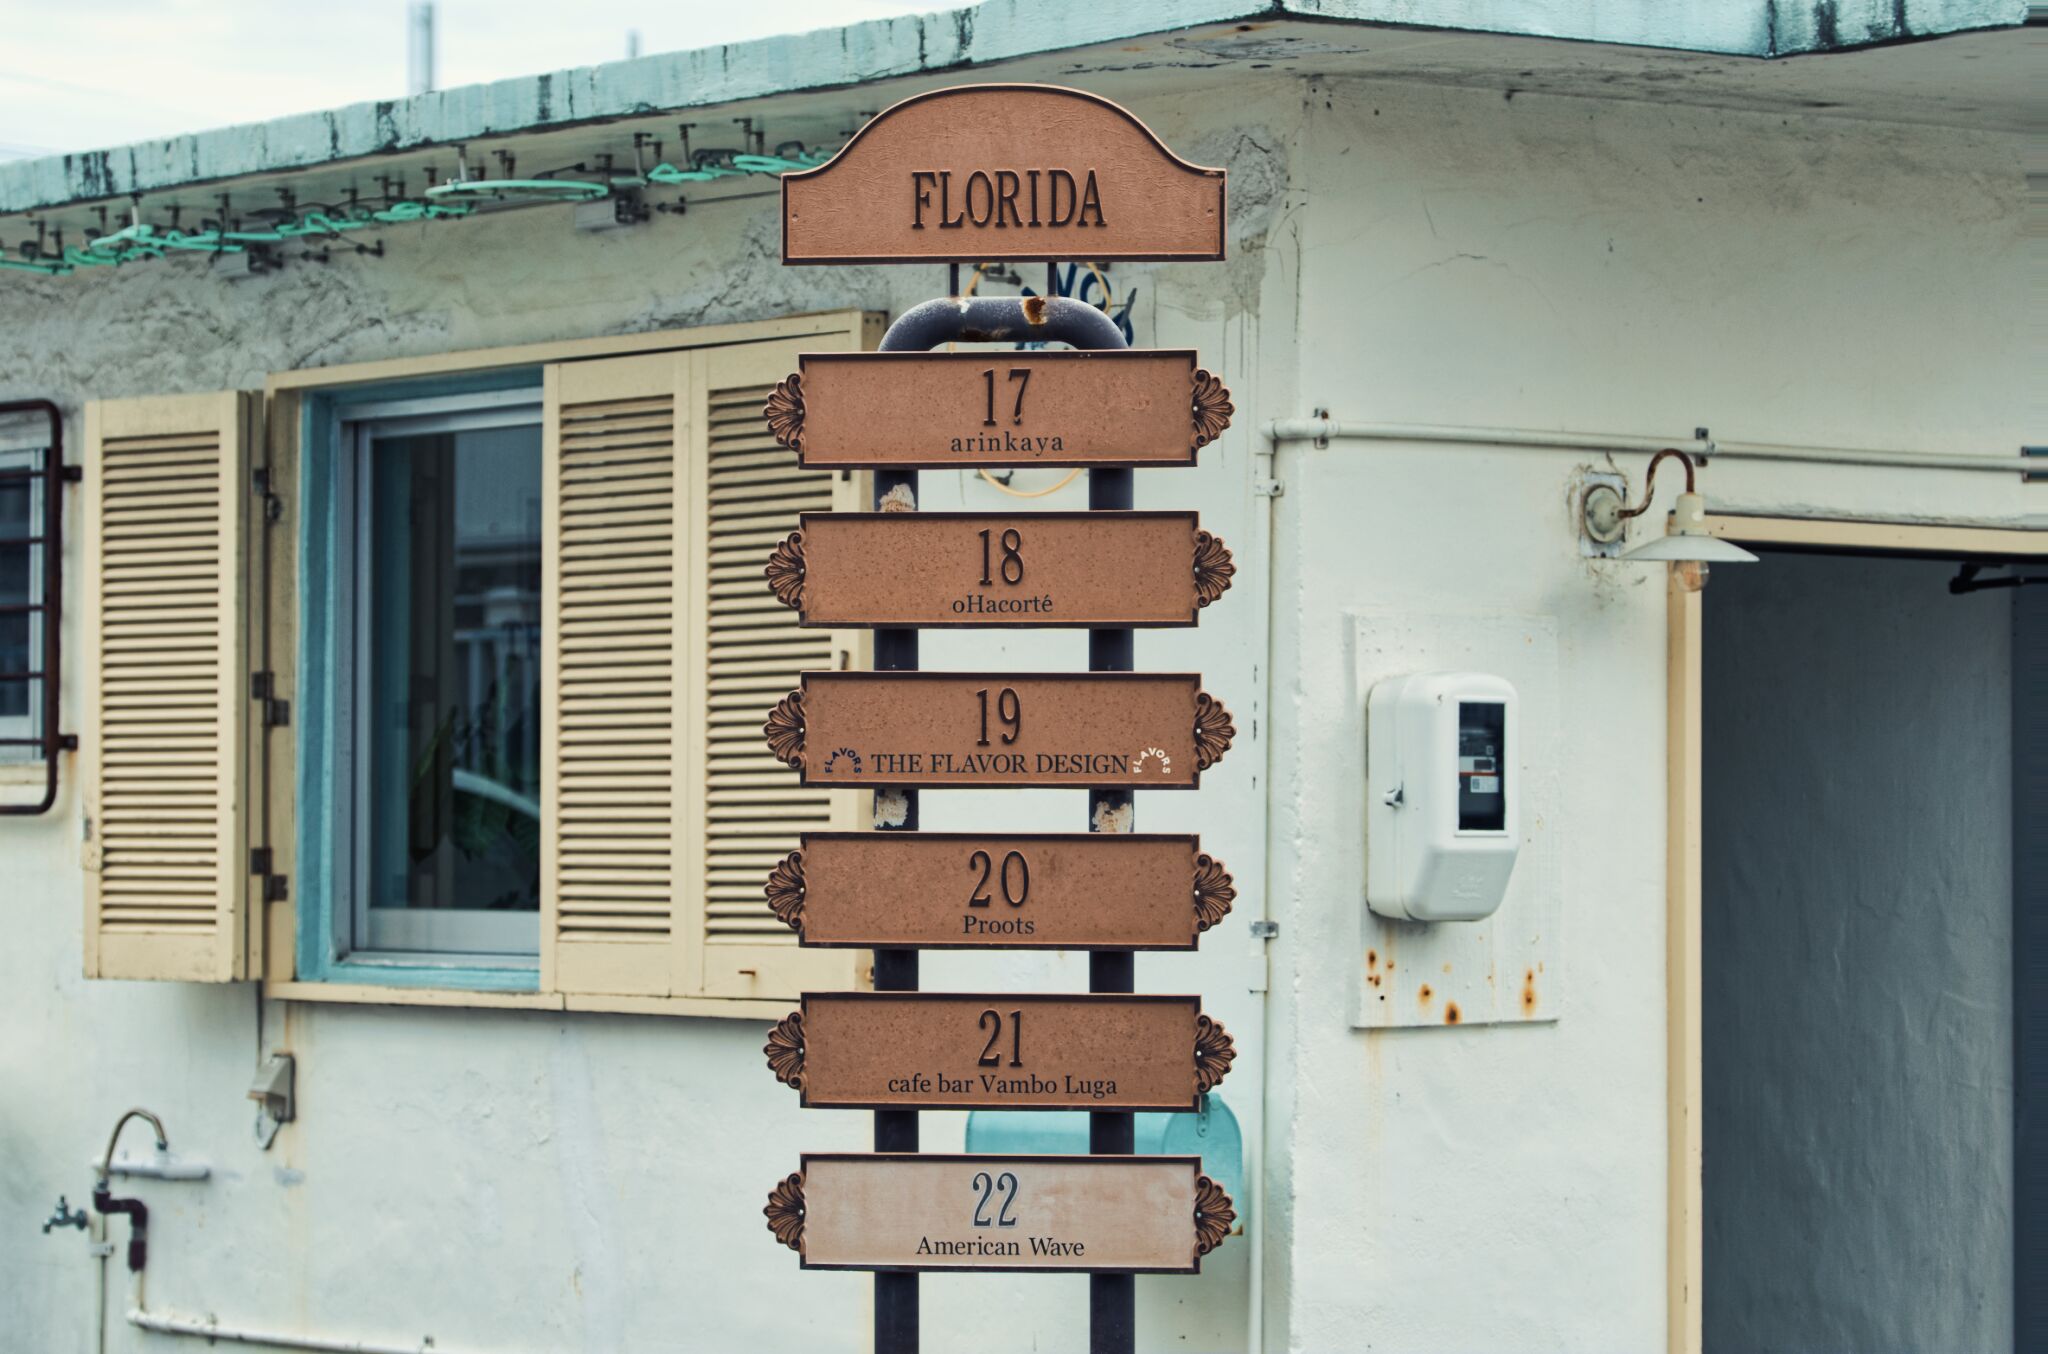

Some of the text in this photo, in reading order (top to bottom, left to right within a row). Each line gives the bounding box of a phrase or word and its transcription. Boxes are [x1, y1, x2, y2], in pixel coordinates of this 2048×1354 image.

[911, 169, 1108, 231] FLORIDA
[982, 368, 1032, 427] 17
[950, 430, 1064, 457] arinkaya
[978, 528, 1024, 587] 18
[952, 594, 1053, 614] oHacorté
[976, 687, 1021, 748] 19
[824, 747, 863, 774] FLAVORS
[870, 753, 1129, 774] THE FLAVOR DESIGN
[1132, 747, 1172, 774] FLAVORS
[968, 850, 1030, 909] 20
[962, 915, 1035, 935] Proots
[977, 1009, 1023, 1069] 21
[888, 1072, 1118, 1099] cafe bar Vambo Luga
[972, 1172, 1018, 1227] 22
[916, 1235, 1085, 1257] American Wave
